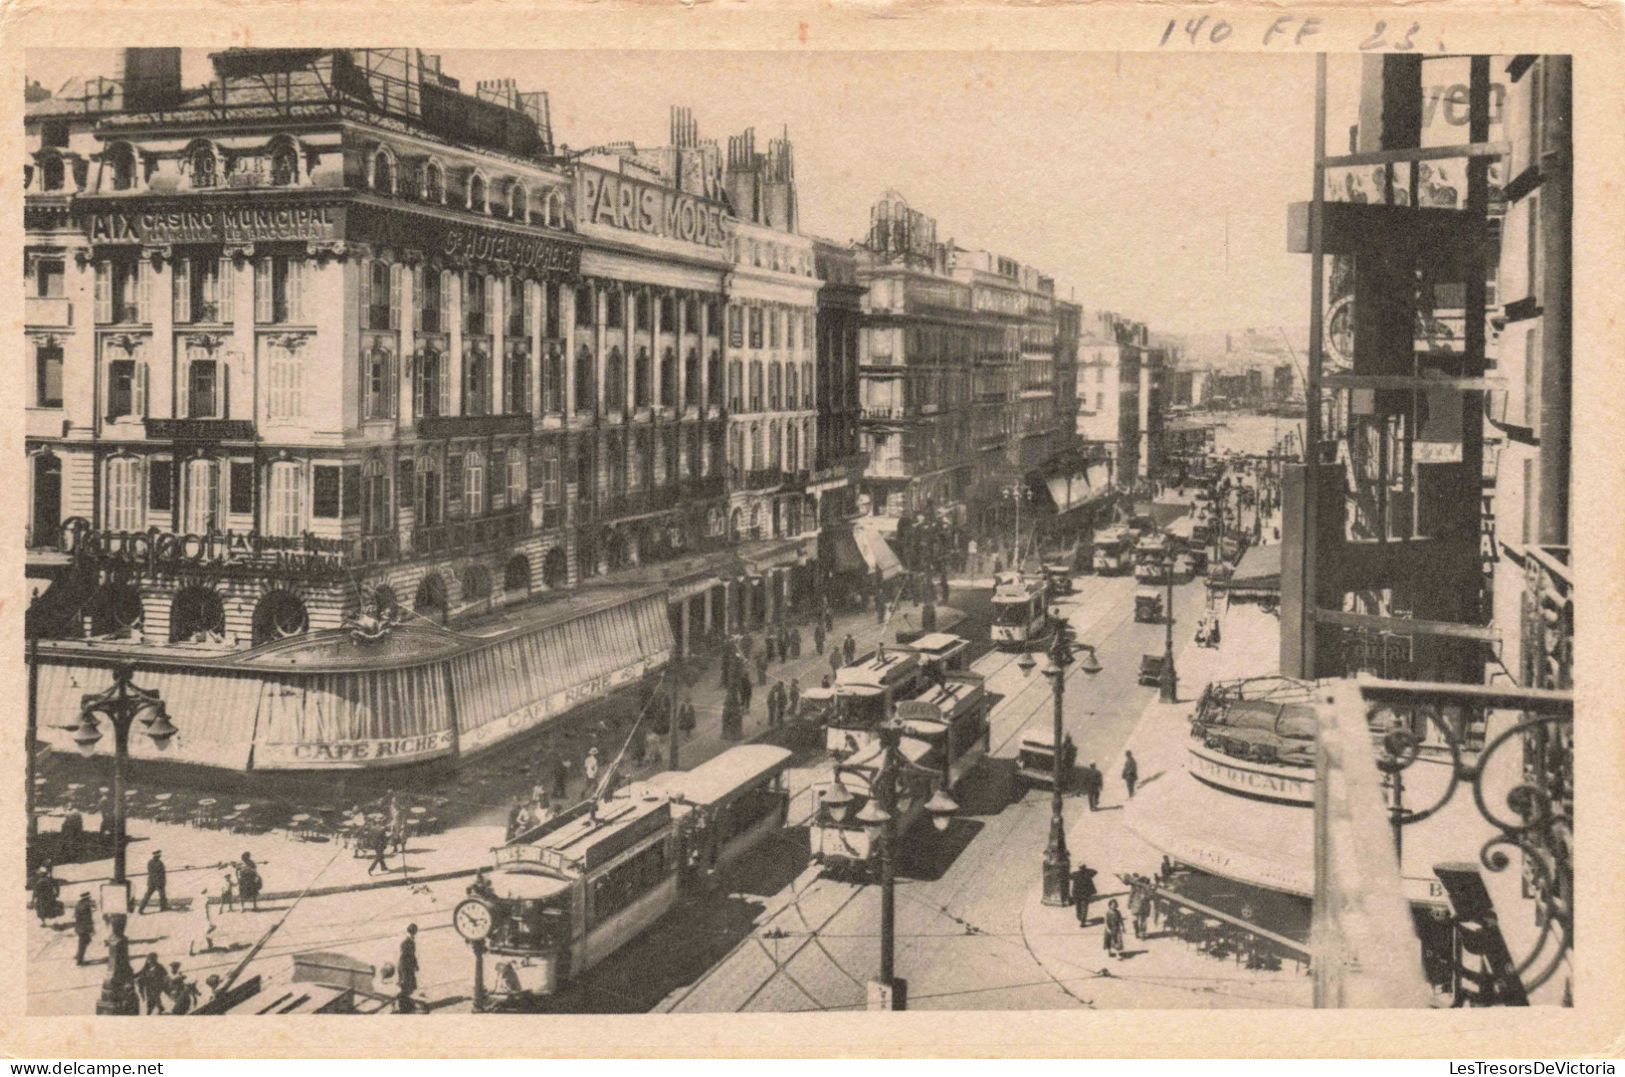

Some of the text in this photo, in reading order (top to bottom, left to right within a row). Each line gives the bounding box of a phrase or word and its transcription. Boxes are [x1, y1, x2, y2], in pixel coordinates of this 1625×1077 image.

[1158, 15, 1234, 47] 140
[1262, 15, 1324, 47] FF
[90, 206, 333, 243] AIX CASINO MUNICIPAL
[576, 170, 730, 248] PARIS MODES
[463, 229, 511, 264] HOTEL
[376, 734, 437, 758] RICHE
